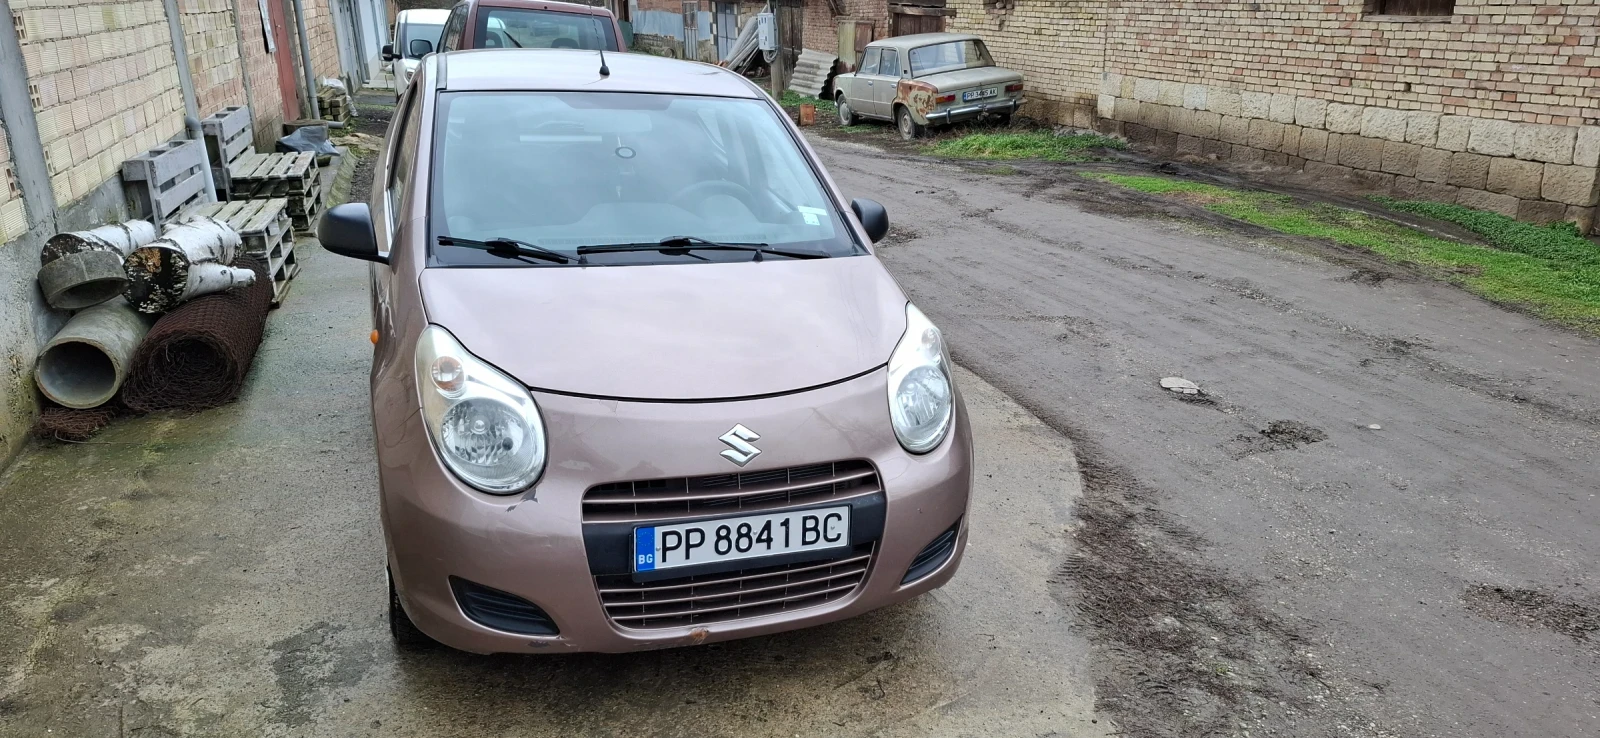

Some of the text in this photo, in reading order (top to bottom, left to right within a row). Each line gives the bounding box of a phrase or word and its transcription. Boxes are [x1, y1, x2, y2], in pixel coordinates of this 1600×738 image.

[661, 512, 843, 563] PP 8841 BC
[638, 550, 653, 565] BG
